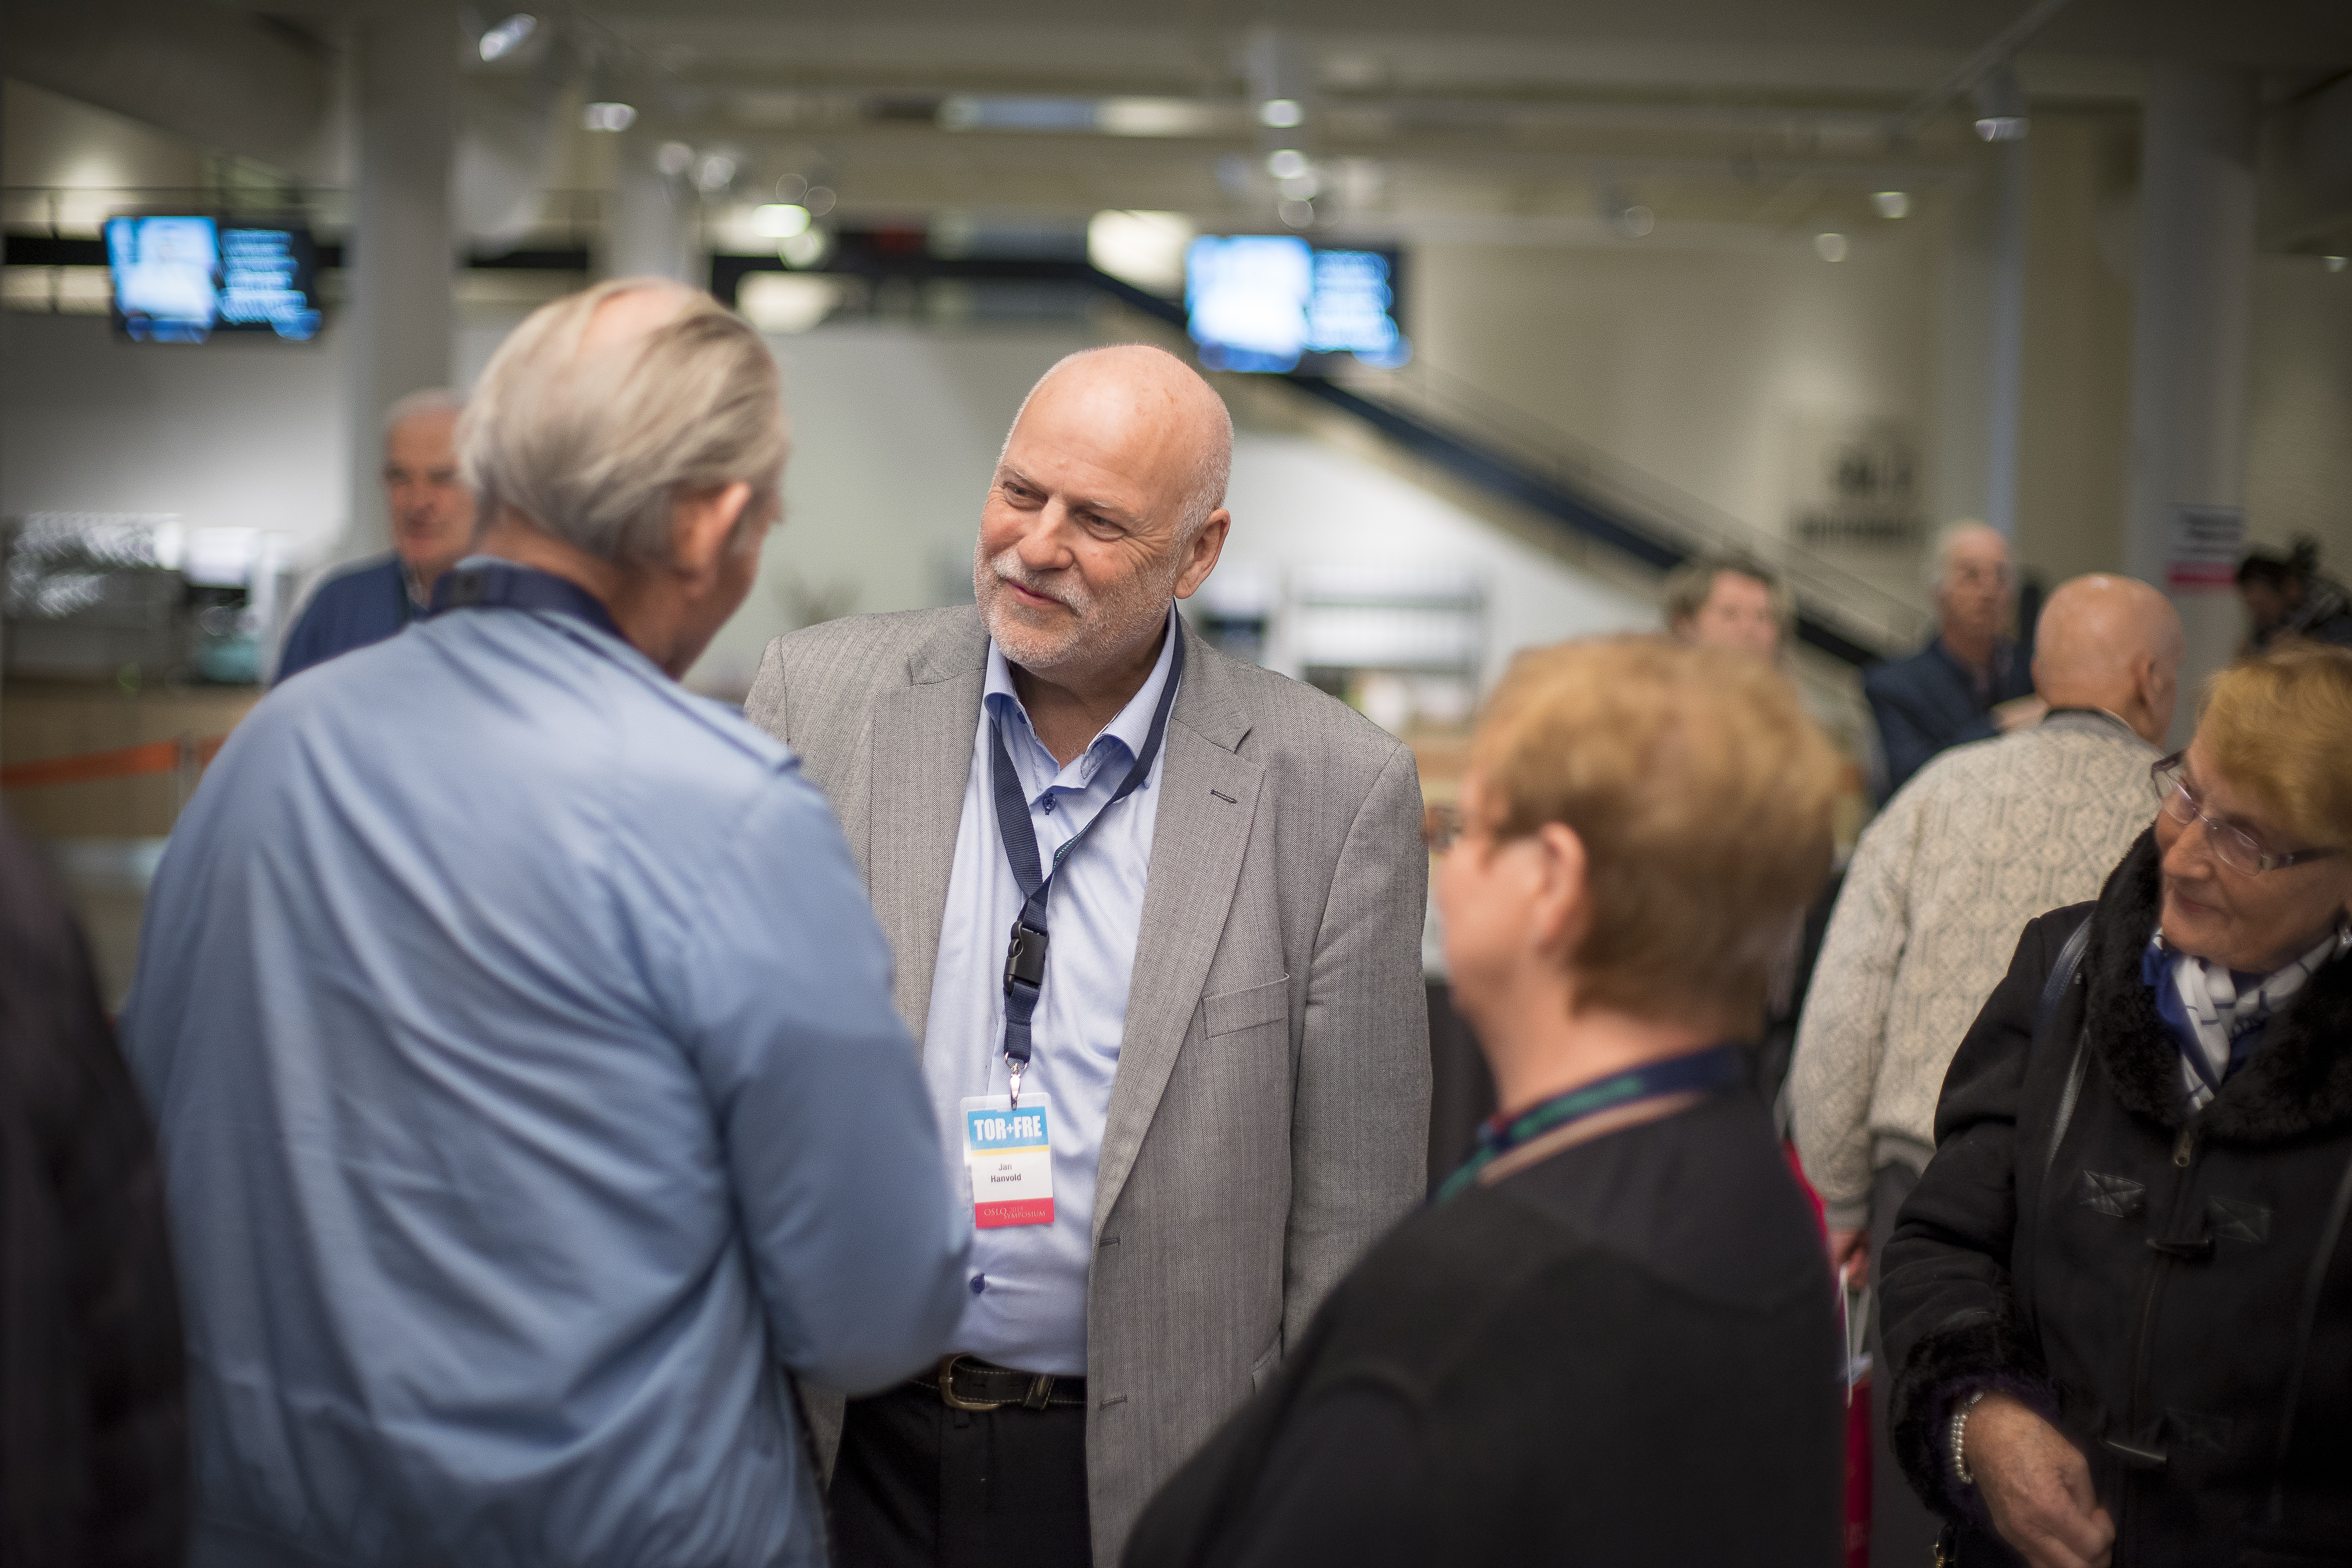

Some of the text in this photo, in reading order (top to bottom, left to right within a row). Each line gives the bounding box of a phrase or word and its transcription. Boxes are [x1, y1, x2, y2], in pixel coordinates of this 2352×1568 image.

[974, 1115, 1042, 1141] TOR+FRE
[991, 1173, 1021, 1182] Hanvold
[984, 1207, 1007, 1216] OSLO
[1004, 1210, 1045, 1219] SYMPOSIUM
